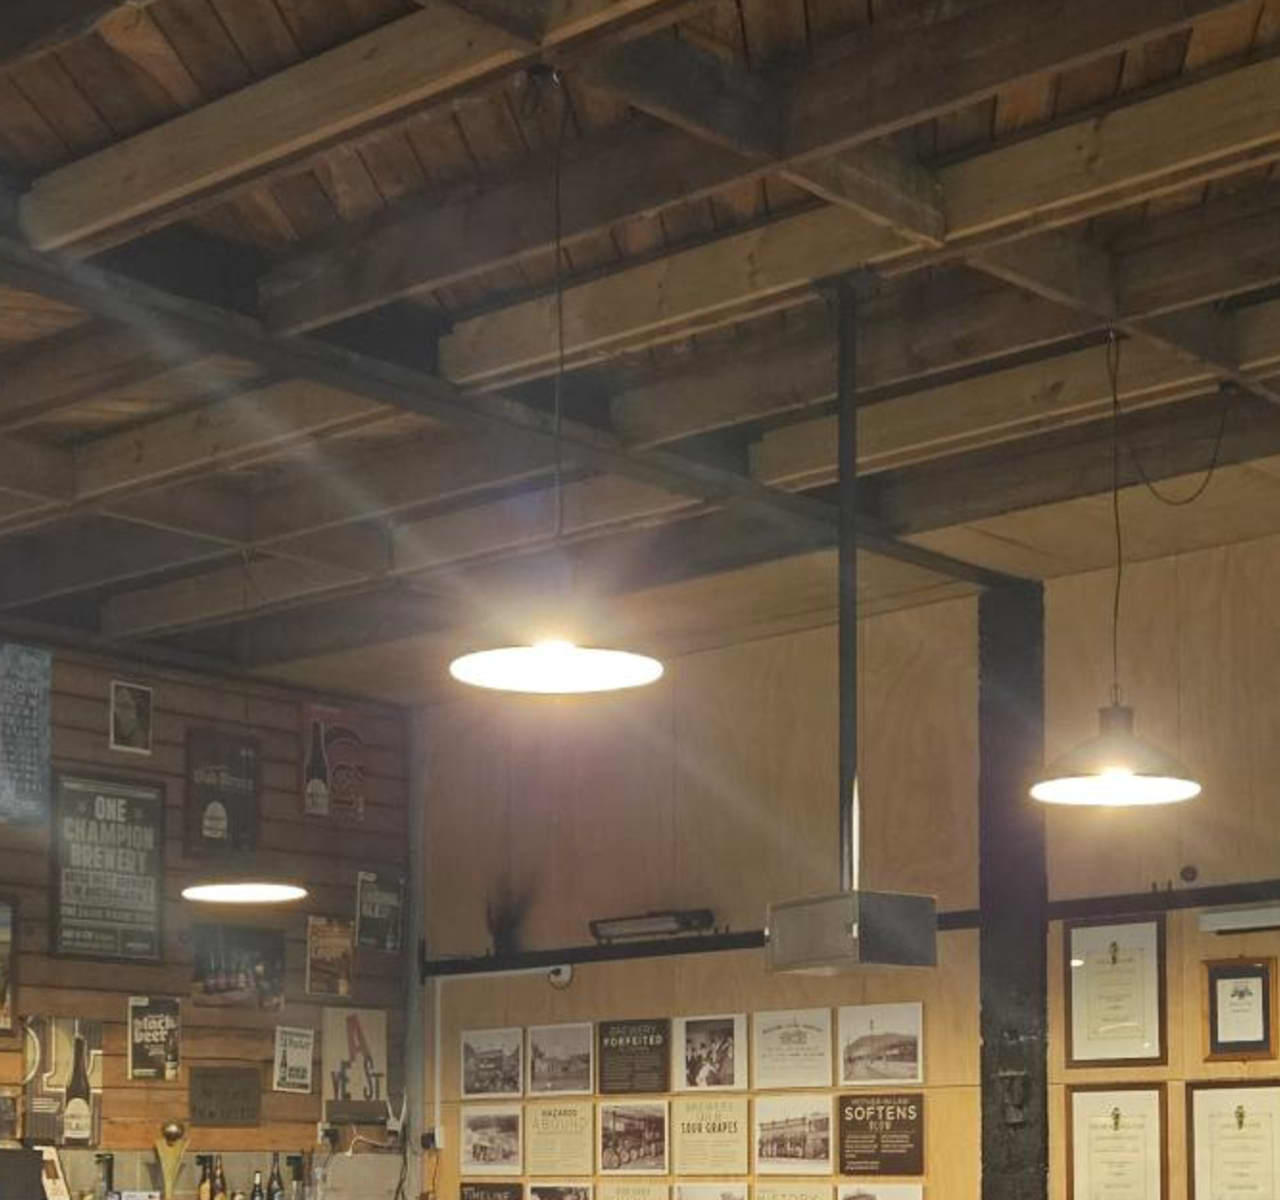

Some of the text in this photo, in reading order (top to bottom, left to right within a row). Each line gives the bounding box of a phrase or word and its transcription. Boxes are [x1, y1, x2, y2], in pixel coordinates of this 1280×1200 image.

[94, 796, 127, 822] ONE
[63, 817, 155, 849] CHAMPION
[70, 843, 147, 873] BREWERY
[603, 1034, 664, 1049] FORFEITED
[844, 1105, 918, 1121] SOFTENS
[706, 1120, 739, 1134] GRAPES
